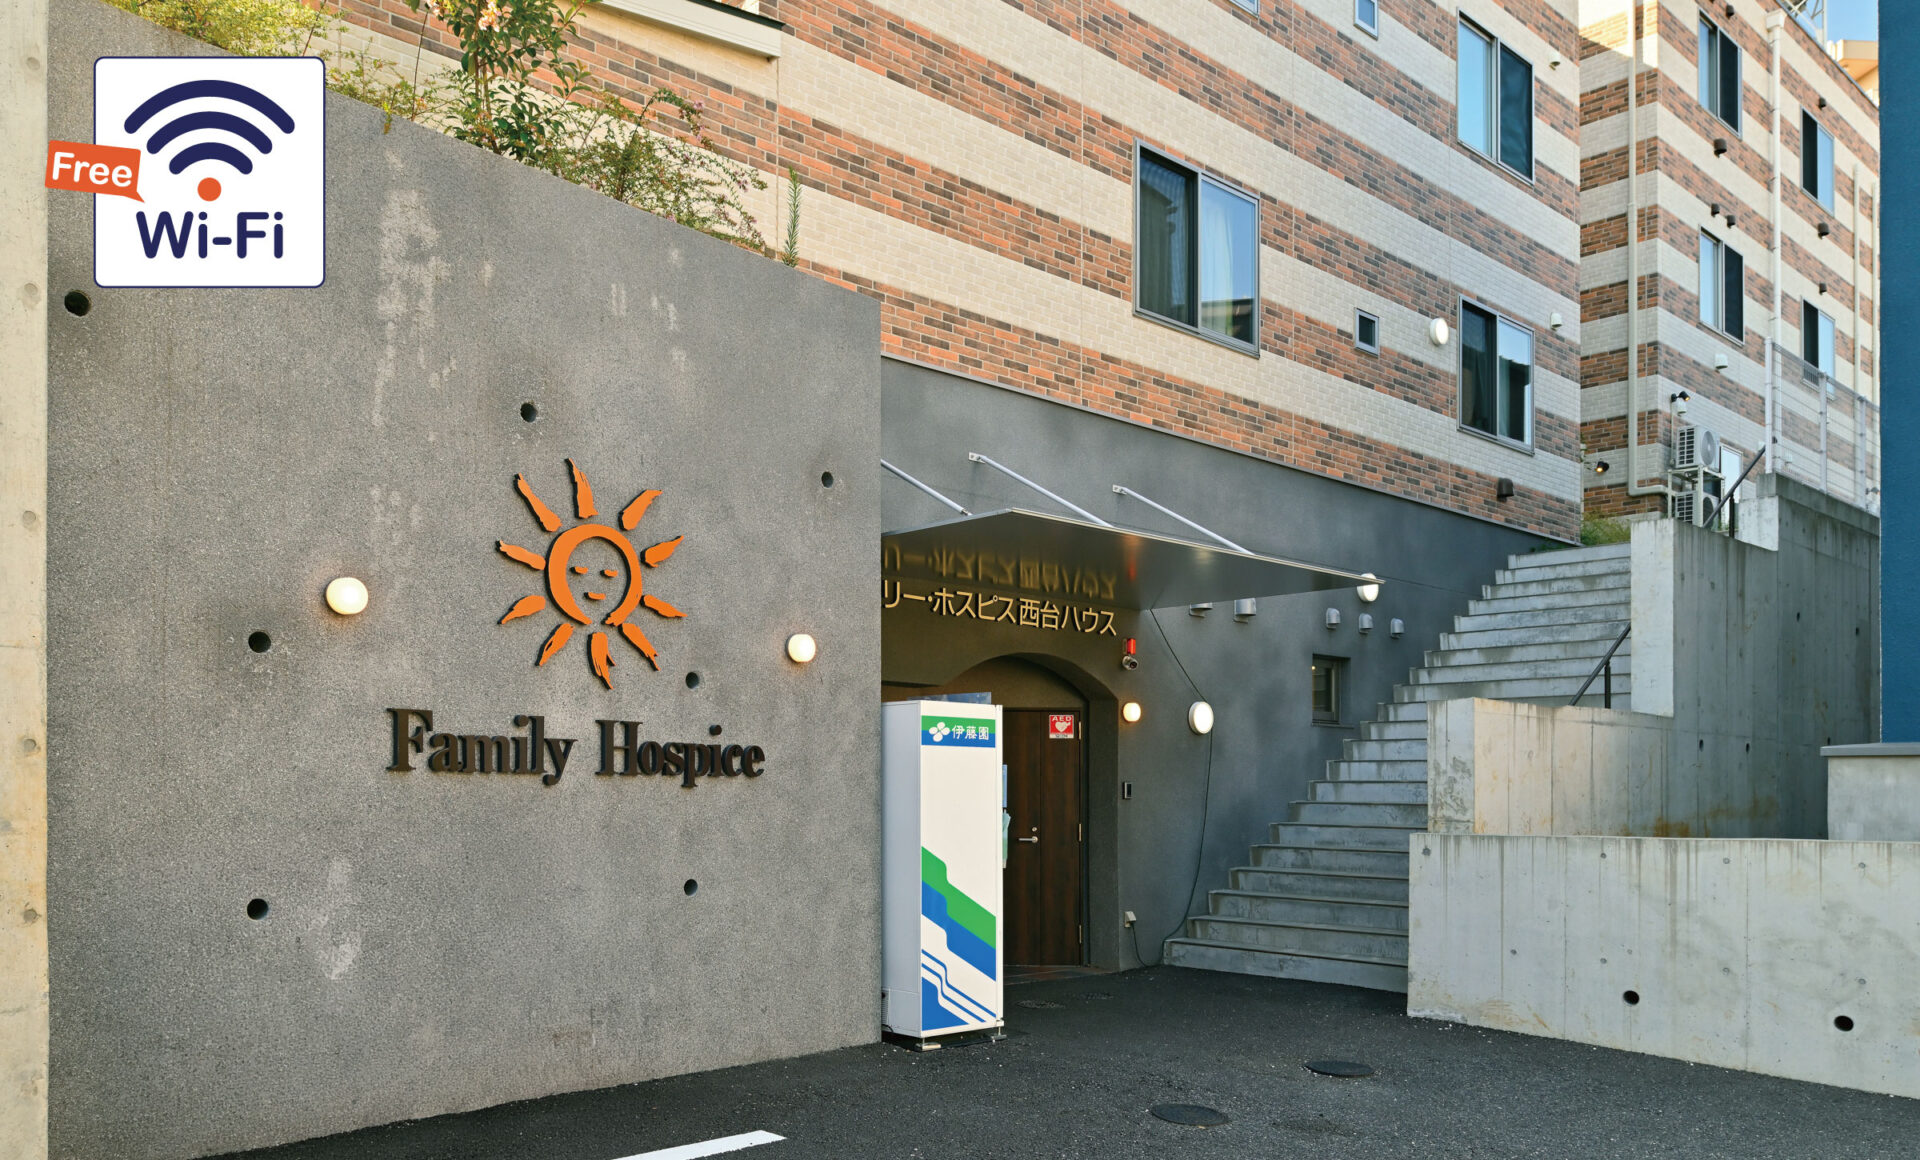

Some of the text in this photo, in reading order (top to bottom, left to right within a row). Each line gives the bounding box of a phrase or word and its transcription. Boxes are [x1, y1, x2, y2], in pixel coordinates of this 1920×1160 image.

[386, 707, 766, 788] Family Hospice
[951, 724, 989, 741] 伊藤園
